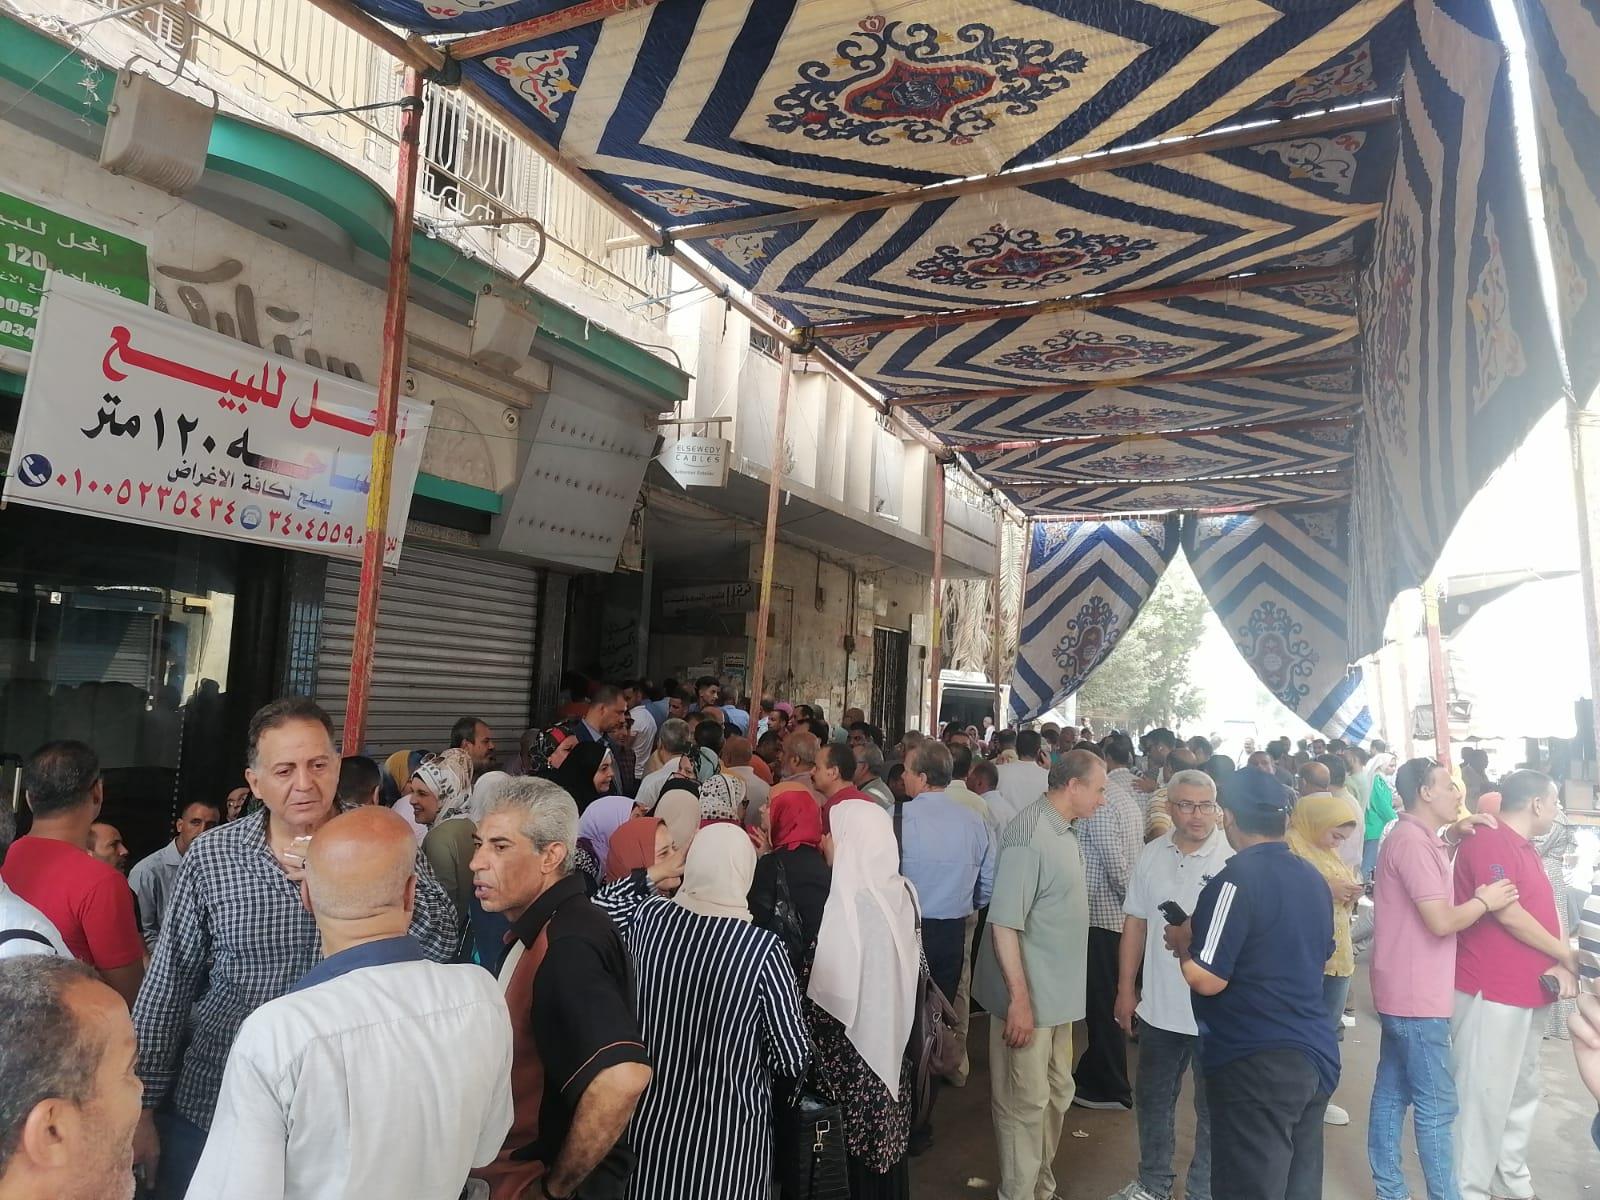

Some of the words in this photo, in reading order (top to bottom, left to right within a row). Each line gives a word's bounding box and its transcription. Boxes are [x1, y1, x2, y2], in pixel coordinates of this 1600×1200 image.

[5, 243, 47, 272] 120
[102, 326, 287, 414] للبيع
[80, 392, 141, 439] متر
[153, 407, 216, 456] ١٢٠
[675, 454, 721, 463] CABLES
[676, 444, 721, 454] ELSEWEDY
[241, 473, 293, 501] لكافة
[297, 489, 333, 515] يصلح
